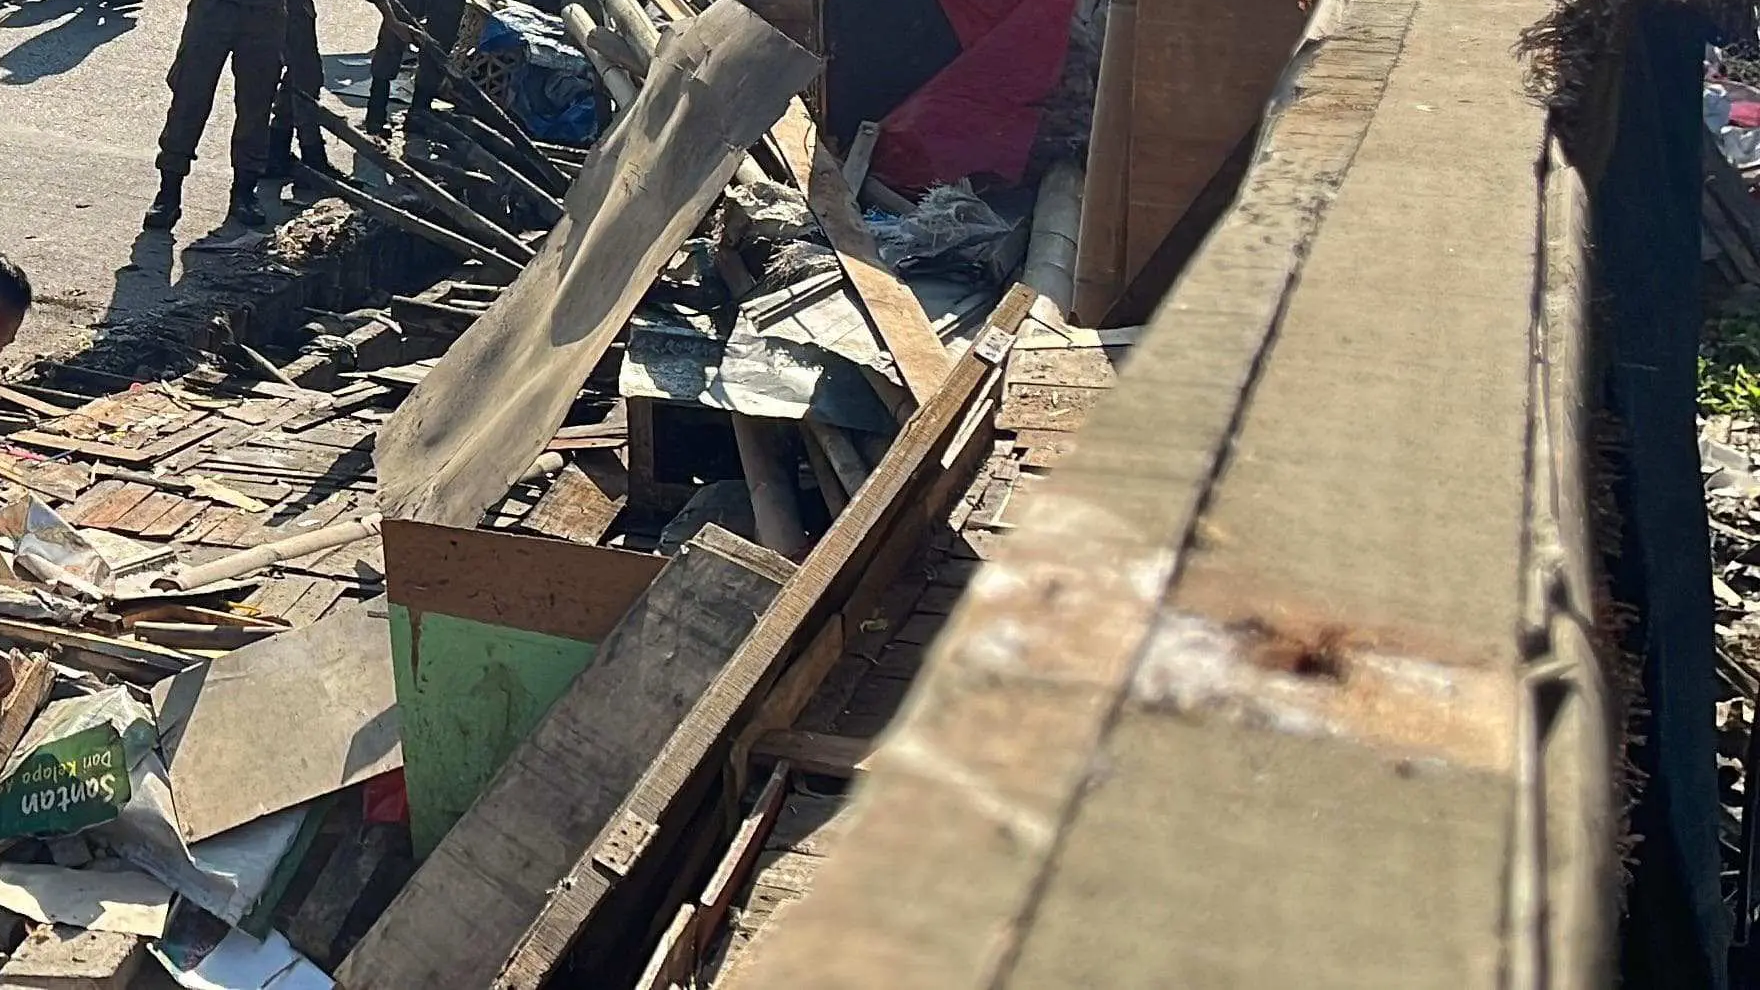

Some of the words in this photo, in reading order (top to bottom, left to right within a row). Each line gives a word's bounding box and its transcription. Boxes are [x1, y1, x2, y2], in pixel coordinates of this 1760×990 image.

[22, 760, 78, 784] Kelapa
[83, 750, 112, 773] Dari
[21, 773, 116, 815] Santan
